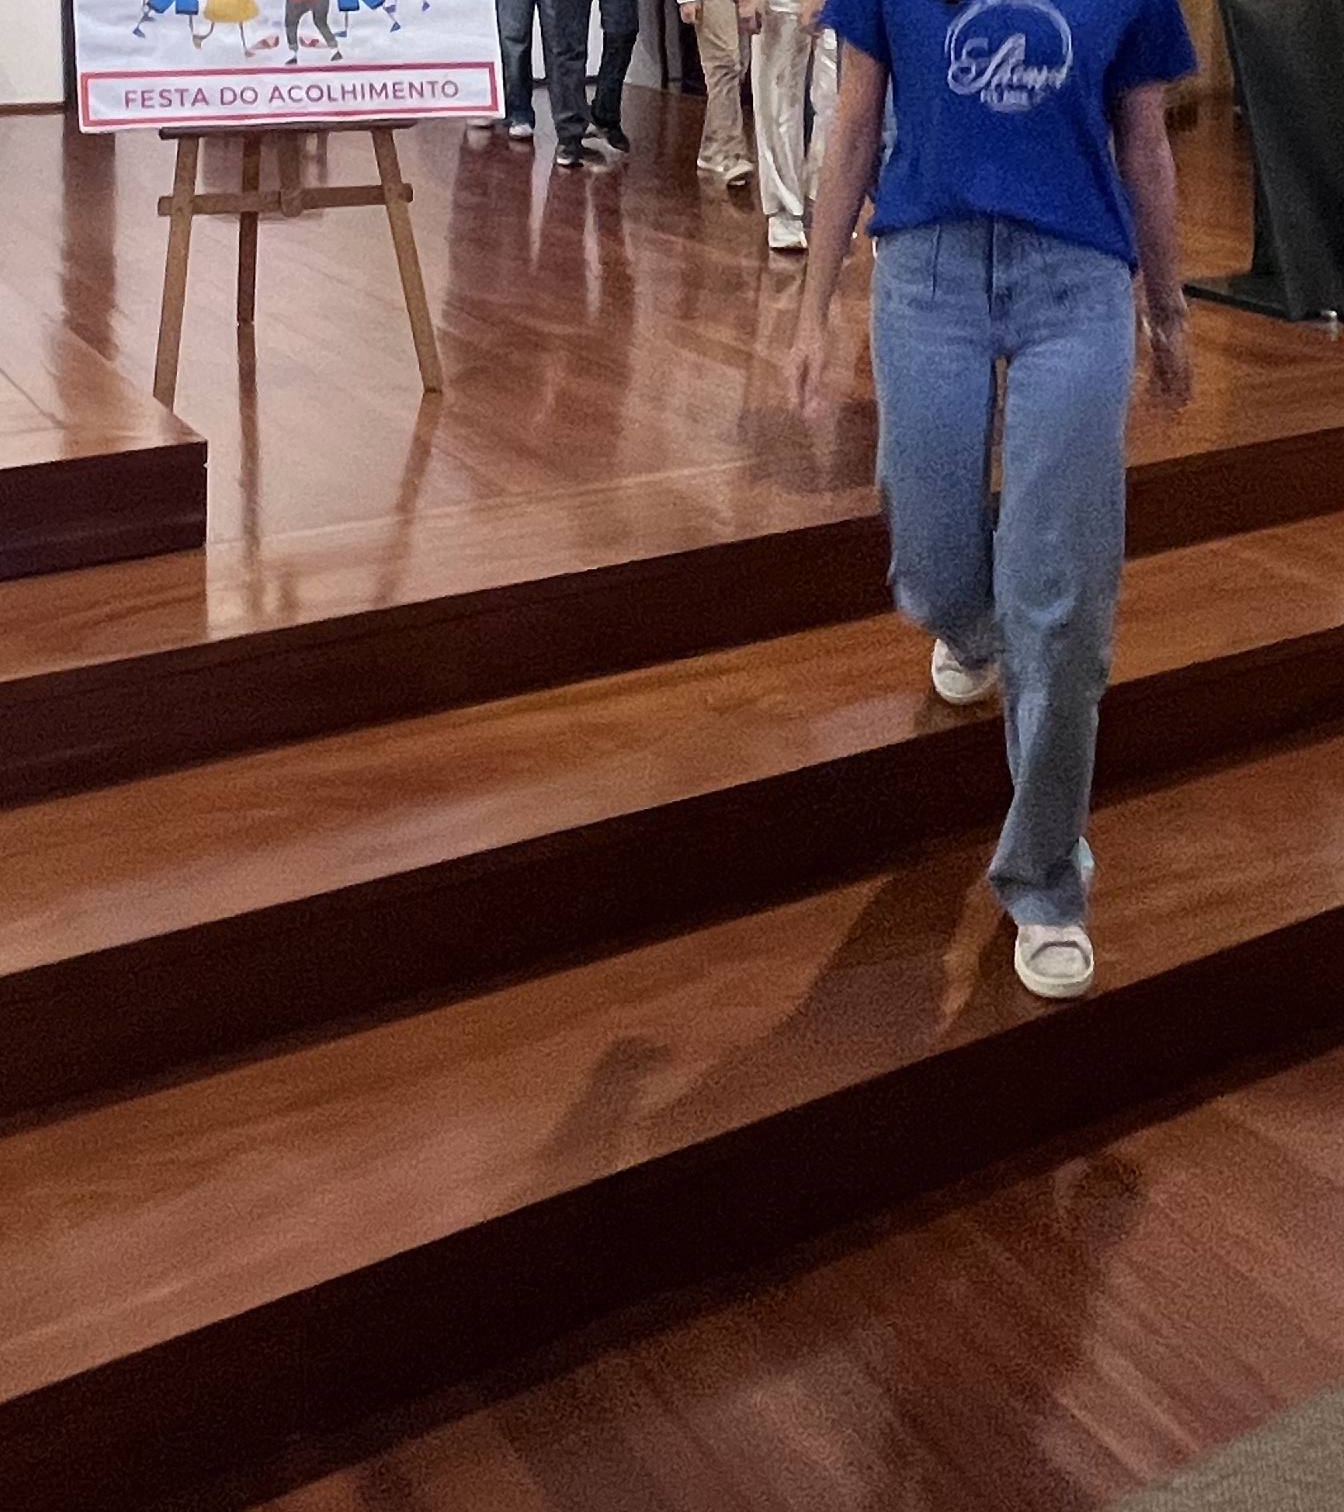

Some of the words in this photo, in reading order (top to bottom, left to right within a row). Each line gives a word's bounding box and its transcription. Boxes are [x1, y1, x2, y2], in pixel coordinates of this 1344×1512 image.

[124, 88, 210, 109] FESTA
[219, 86, 259, 106] DO
[268, 80, 460, 104] ACOLHIMENTO
